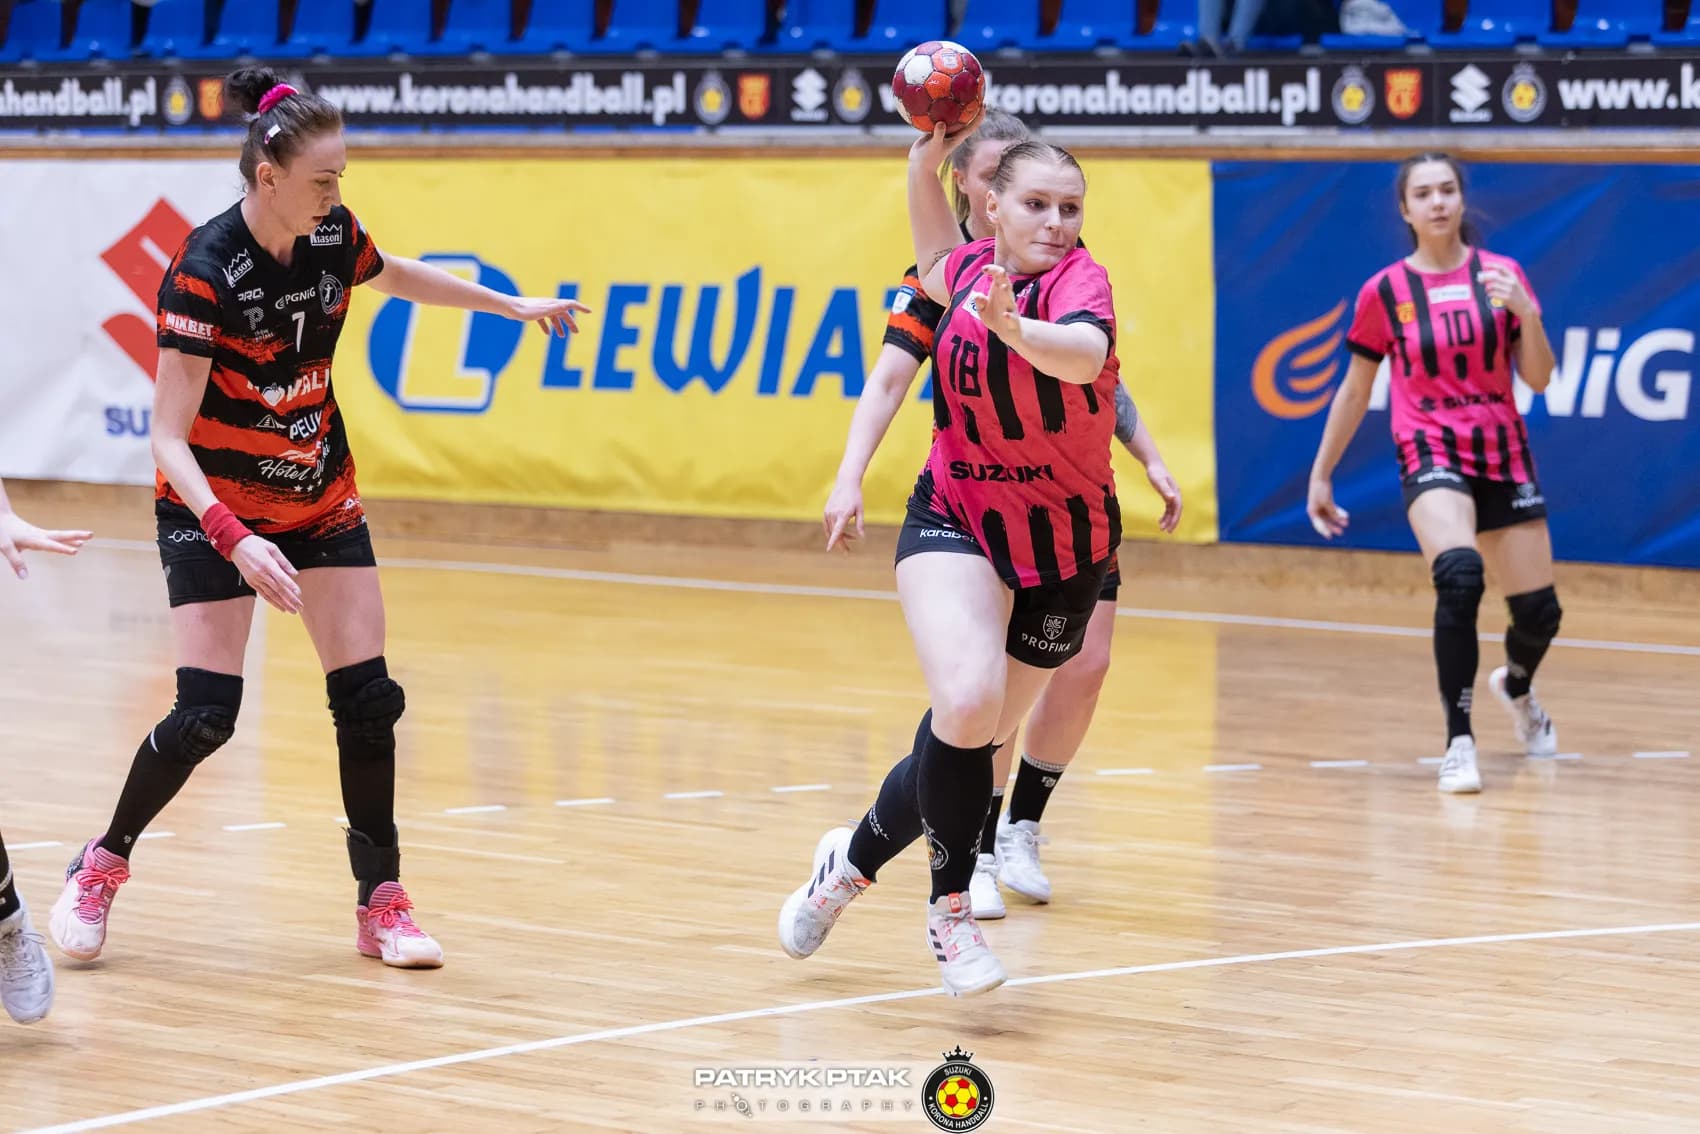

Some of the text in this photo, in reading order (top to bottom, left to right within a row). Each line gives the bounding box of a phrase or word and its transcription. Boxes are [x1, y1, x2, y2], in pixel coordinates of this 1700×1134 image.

[0, 77, 156, 127] handball.pl
[318, 71, 686, 125] www.koronahandball.pl
[879, 68, 1320, 126] koronahandball.pl
[285, 286, 316, 305] PGNiG
[292, 311, 305, 351] 7
[540, 264, 934, 400] LEWIA
[1439, 309, 1476, 347] 10
[950, 334, 982, 398] 18
[258, 459, 312, 481] Hotel
[950, 460, 1054, 482] SUZUKI
